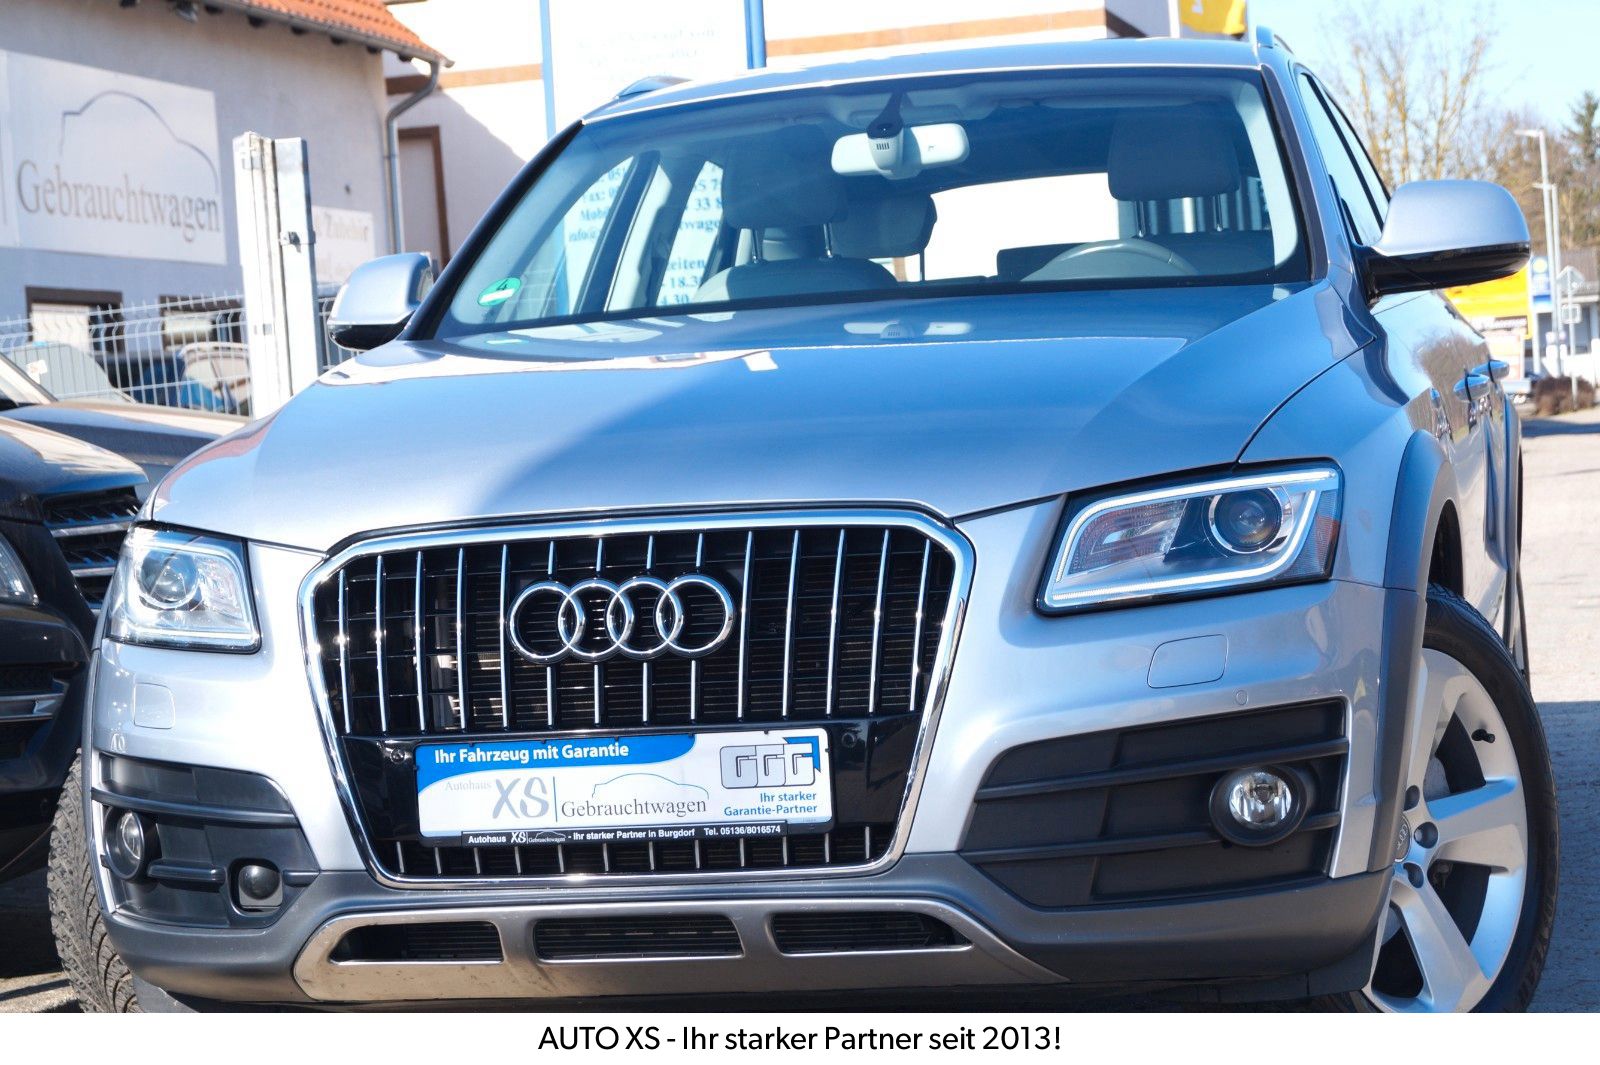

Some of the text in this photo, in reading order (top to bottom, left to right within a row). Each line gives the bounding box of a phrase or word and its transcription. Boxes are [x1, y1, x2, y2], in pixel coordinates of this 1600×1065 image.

[16, 159, 221, 243] Gebrauchtwagen
[434, 742, 630, 764] Ihr Fahrzeug mit Garantie
[444, 776, 550, 820] Autohaus XS
[759, 791, 817, 803] Ihr starker
[561, 798, 707, 818] Gebrauchtwagen
[724, 803, 818, 817] Garantie-Partner
[468, 835, 507, 844] Autohaus
[510, 831, 527, 844] XS
[573, 832, 585, 841] Ihr
[586, 831, 615, 840] starker
[616, 829, 646, 840] Partner
[648, 829, 656, 838] in
[658, 828, 696, 840] Burgdorf
[704, 827, 719, 836] Tel.
[720, 825, 781, 836] 05136/8016574
